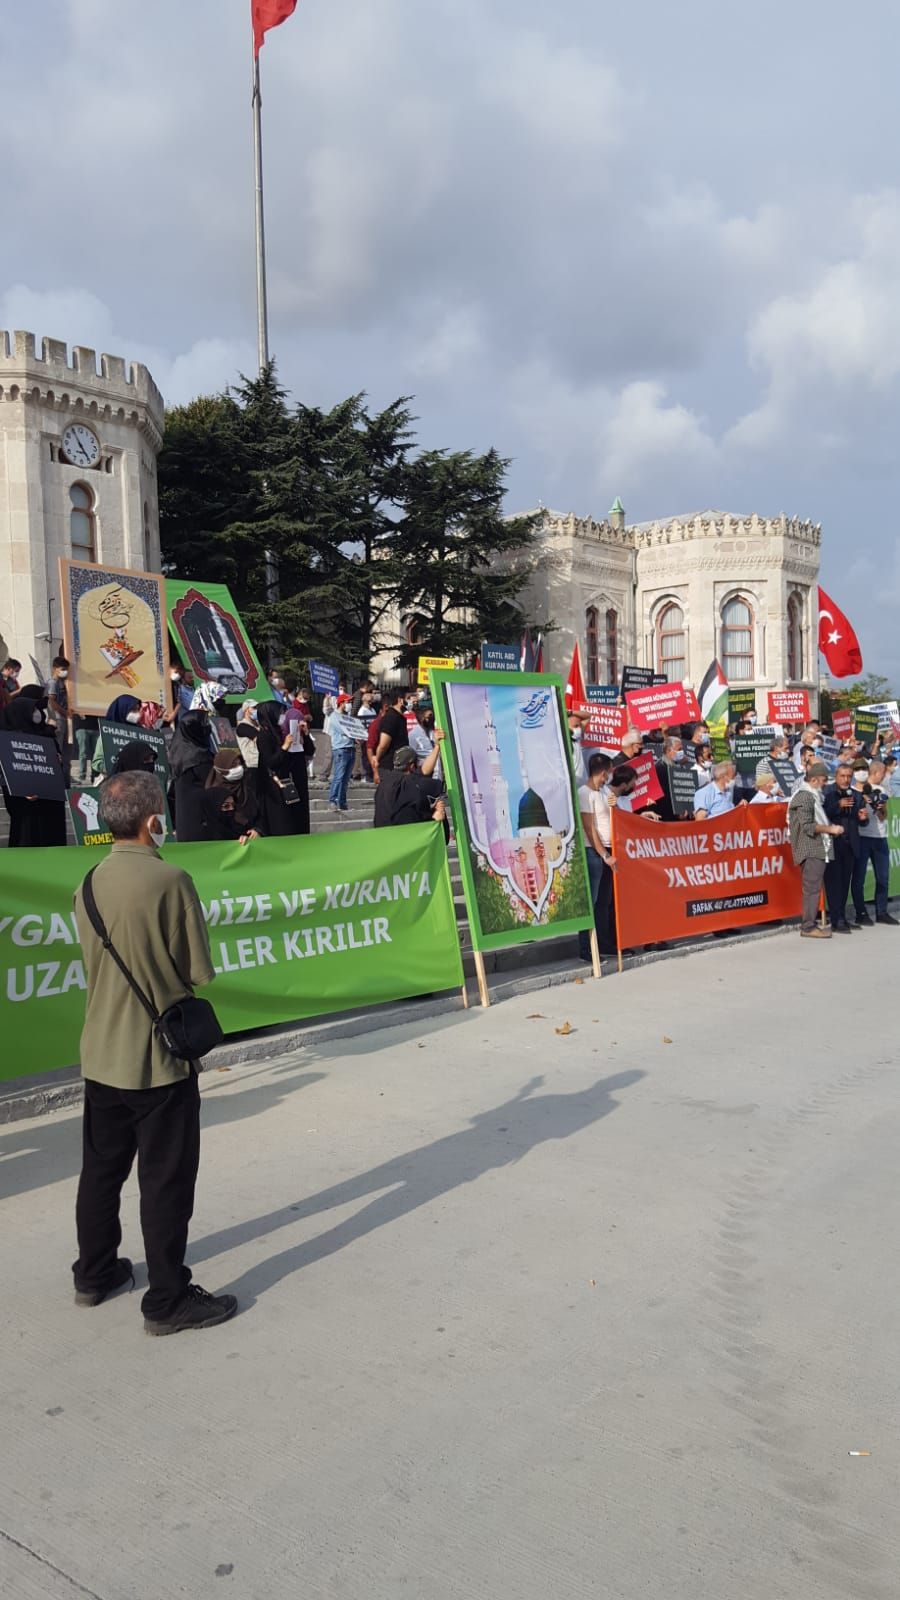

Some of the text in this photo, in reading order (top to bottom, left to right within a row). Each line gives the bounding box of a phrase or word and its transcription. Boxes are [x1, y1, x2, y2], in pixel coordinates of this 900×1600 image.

[580, 704, 622, 718] KUR'AN'A
[776, 712, 804, 720] KIRILSIN
[590, 716, 621, 727] ZANAN
[102, 726, 138, 739] CHARLIE
[138, 732, 164, 744] HEBDO
[590, 724, 614, 735] ELLER
[584, 733, 621, 745] KIRILSIN
[11, 740, 44, 752] MACRON
[14, 752, 46, 763] WILL PAY
[12, 762, 54, 775] HIGH PRICE
[625, 826, 790, 858] CANLARIMIZ SANA FEDA
[664, 856, 784, 888] YA RESULALLAH
[279, 888, 317, 918] VE
[323, 871, 432, 911] KURAN'A
[692, 902, 714, 916] ŞAFAK
[283, 917, 392, 961] KIRILIR
